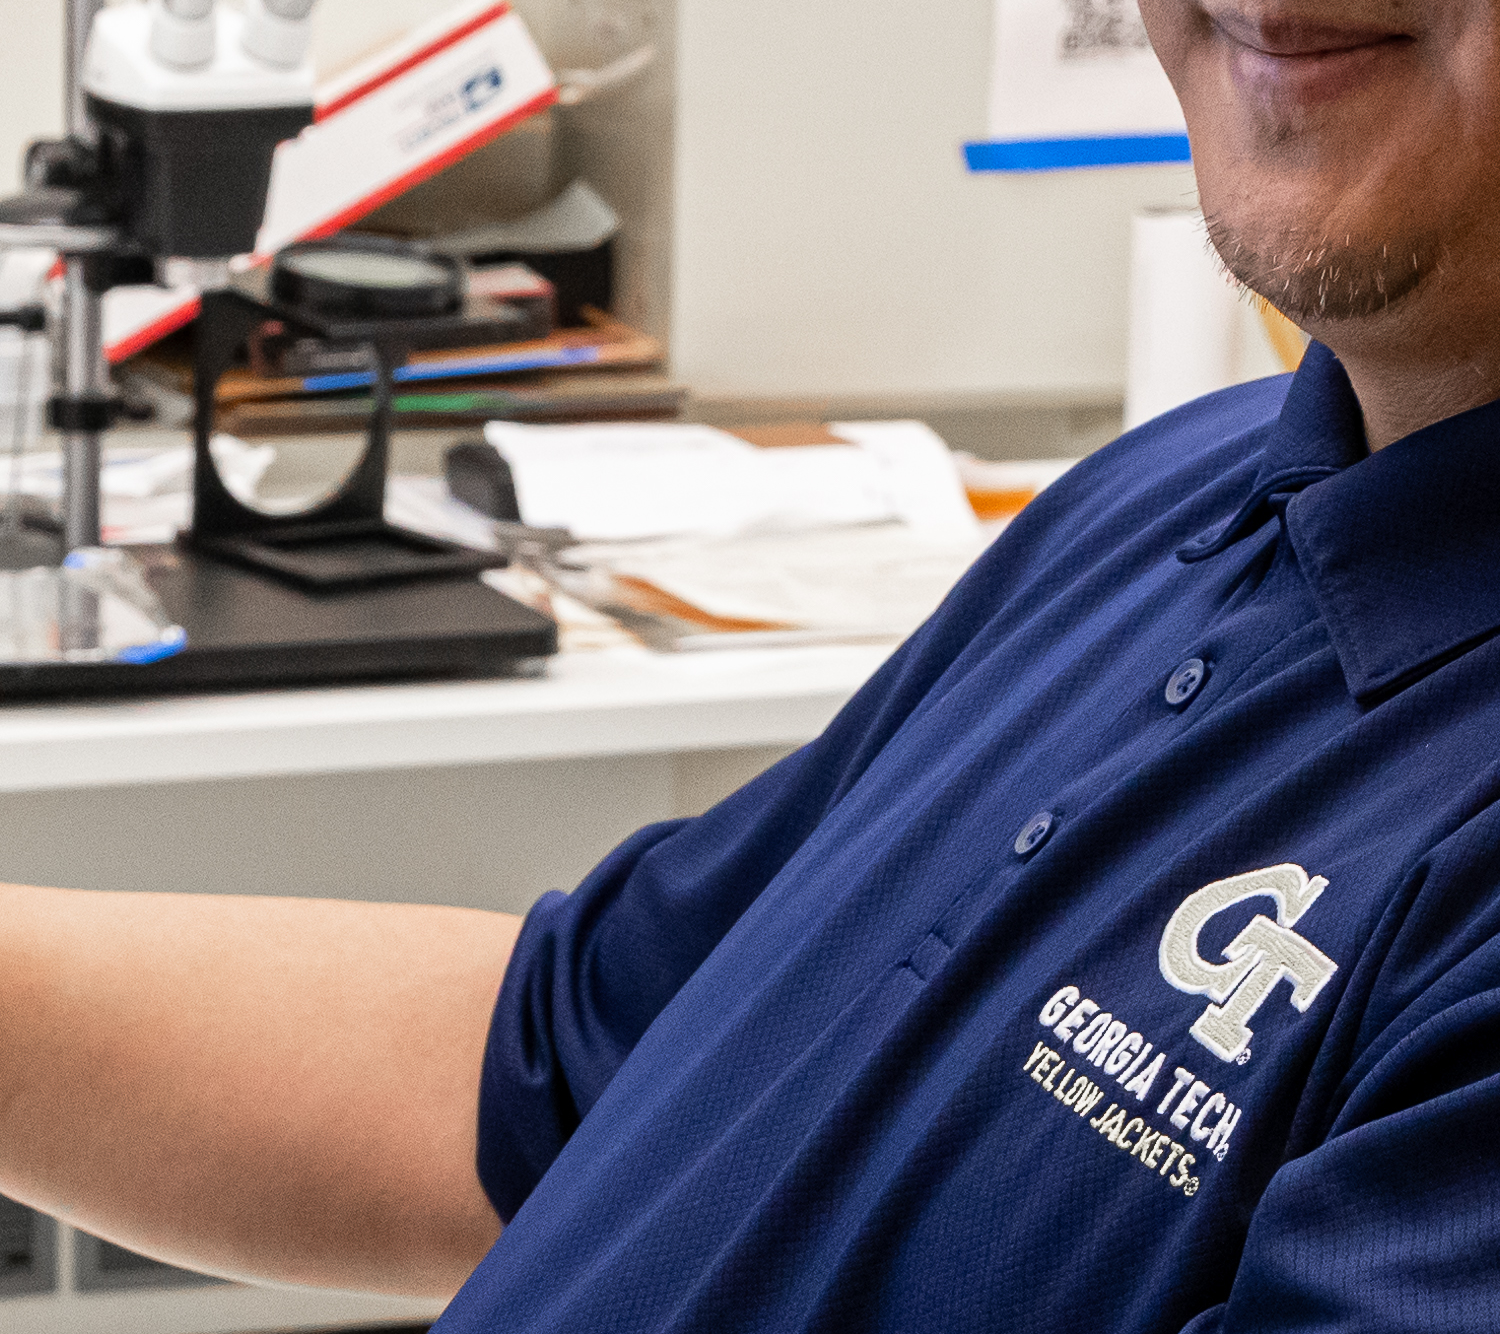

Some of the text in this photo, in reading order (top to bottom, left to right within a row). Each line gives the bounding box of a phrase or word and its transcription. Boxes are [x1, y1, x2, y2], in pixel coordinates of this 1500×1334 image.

[1038, 985, 1167, 1101] GEORGIA
[1023, 1040, 1197, 1188] YELLOW JACKETS
